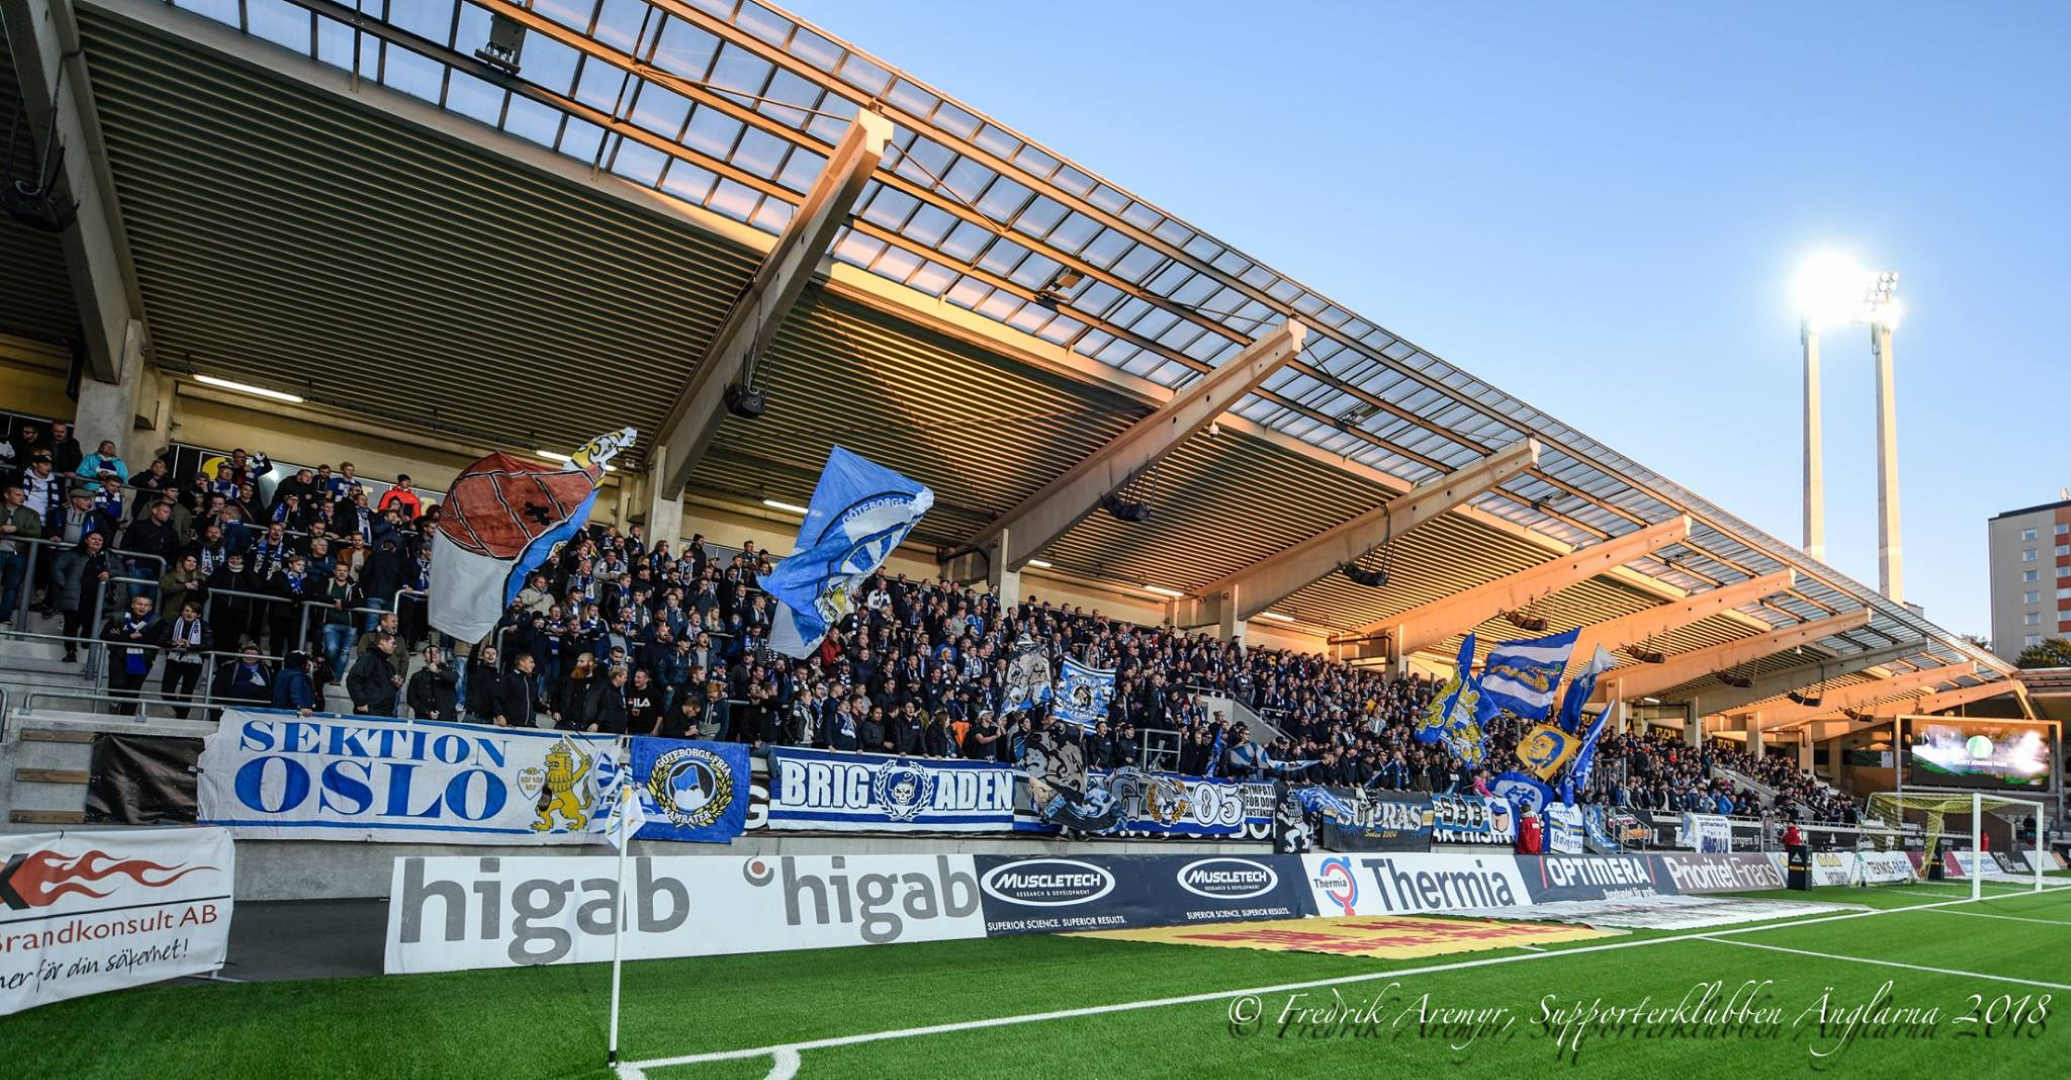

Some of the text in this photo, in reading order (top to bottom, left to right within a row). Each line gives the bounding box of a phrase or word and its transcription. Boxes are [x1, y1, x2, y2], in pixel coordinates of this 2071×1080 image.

[239, 720, 511, 768] SEKTION
[234, 756, 507, 821] OSLO
[1016, 890, 1045, 898] RESEARCH
[1052, 889, 1090, 898] DEVELOPMENT
[1313, 877, 1347, 889] Thermia
[1361, 857, 1516, 913] Thermia
[1547, 858, 1651, 887] OPTIMERA
[400, 857, 690, 964] higab
[781, 855, 979, 943] higab
[1186, 911, 1215, 920] SUPERIOR
[1241, 908, 1268, 917] SUPERIOR
[0, 904, 218, 954] randkonsult AB
[987, 916, 1127, 931] SUPERIOR SCIENCE. SUPERIOR RESULTS.
[36, 959, 64, 993] för
[67, 957, 99, 980] din
